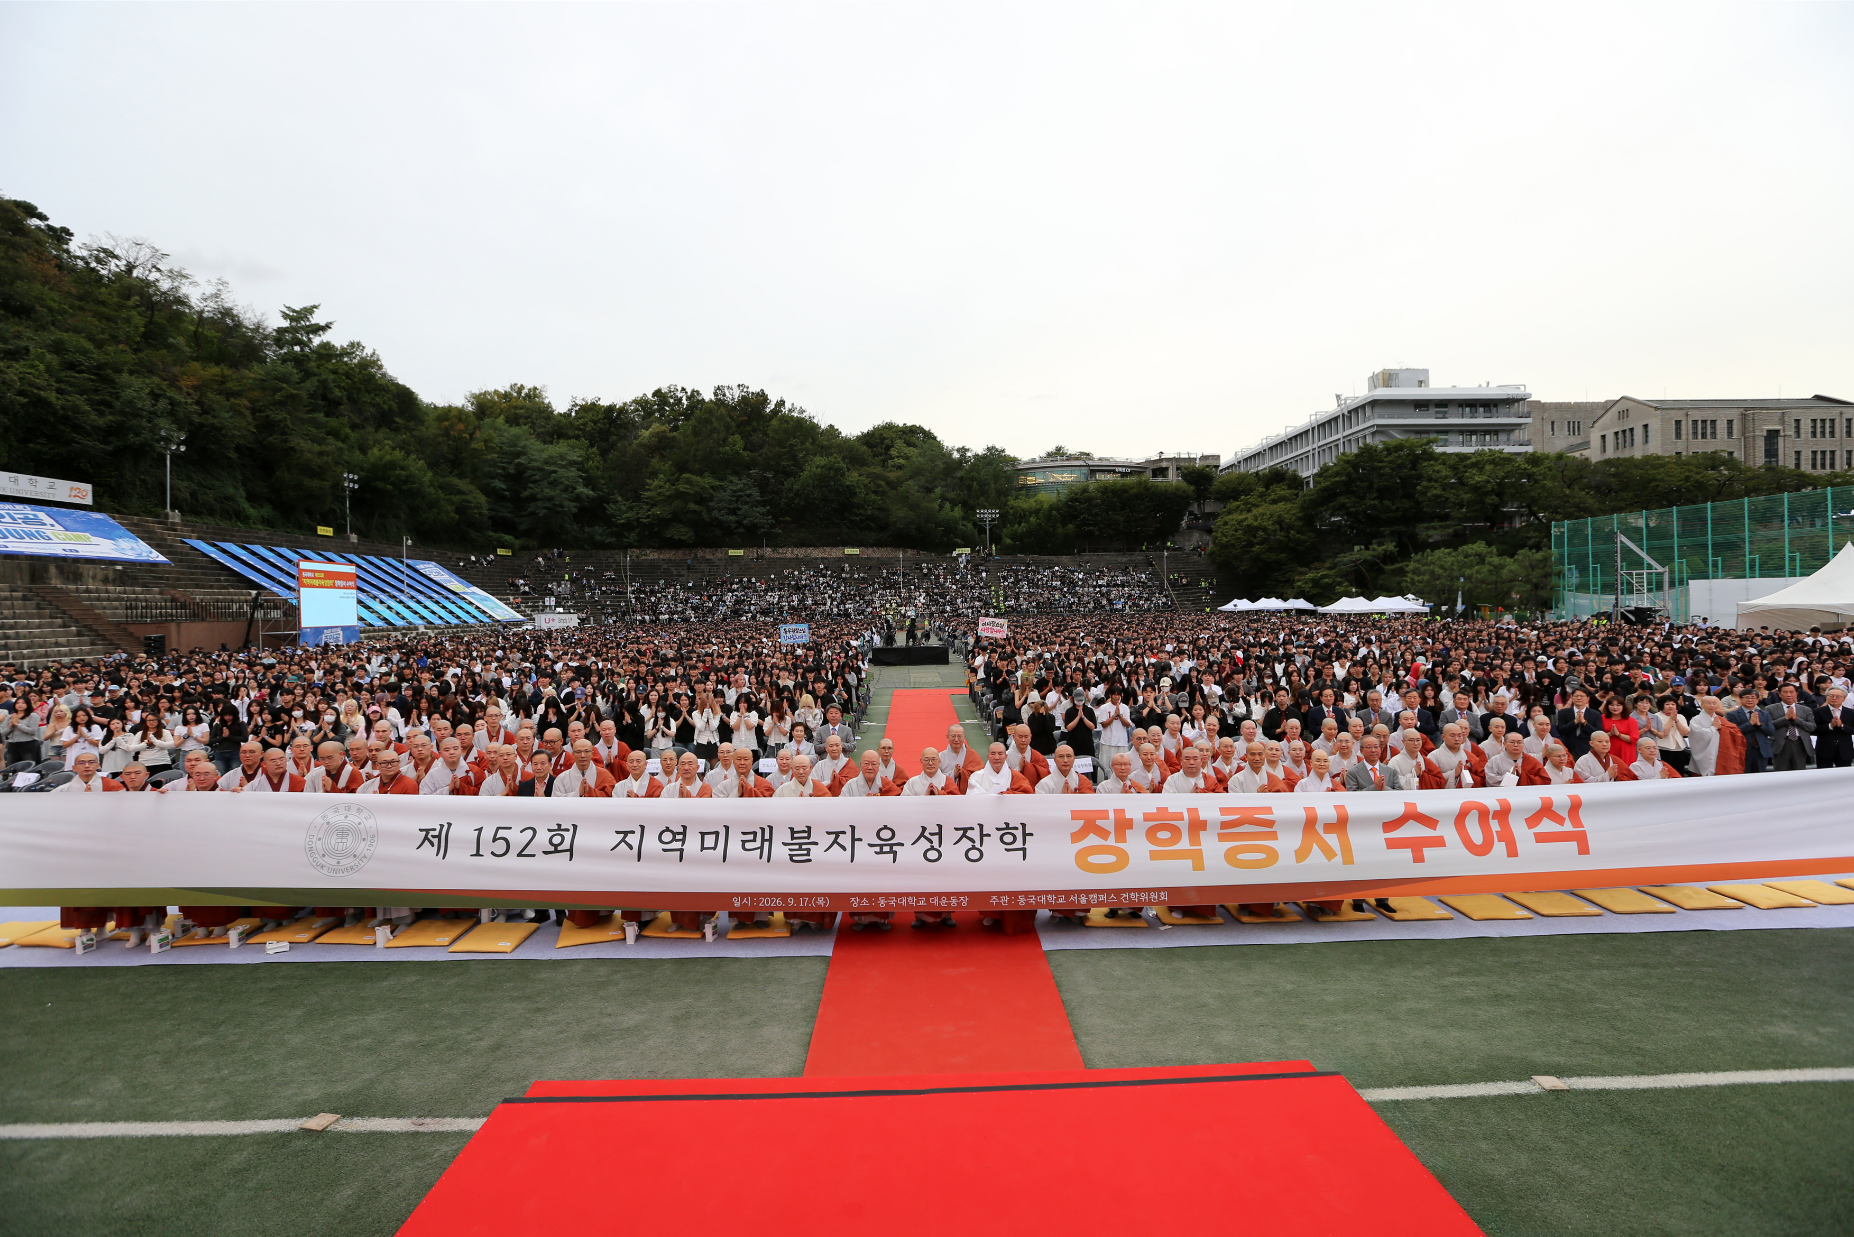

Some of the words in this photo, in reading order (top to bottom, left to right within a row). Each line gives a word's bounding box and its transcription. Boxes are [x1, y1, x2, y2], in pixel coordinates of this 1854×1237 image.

[10, 487, 57, 499] UNIVERSITY
[51, 530, 92, 543] CAMP
[320, 804, 372, 822] 동국대학교
[415, 821, 453, 861] 제
[469, 823, 578, 862] 152회
[610, 821, 1034, 864] 지역미래불자육성장학
[1070, 804, 1355, 875] 장학증서
[1381, 794, 1591, 864] 수여식
[306, 834, 326, 871] DONGGUK
[326, 853, 368, 875] UNIVERSITY
[366, 833, 376, 852] 1906
[732, 896, 752, 908] 일시
[758, 896, 785, 907] 2026.
[849, 896, 870, 908] 장소
[877, 896, 927, 908] 동국대학교
[929, 895, 969, 908] 대운동장
[989, 895, 1010, 907] 주관
[1017, 894, 1067, 906] 동국대학교
[1068, 893, 1118, 905] 서울캠퍼스
[1119, 891, 1169, 903] 건학위원회
